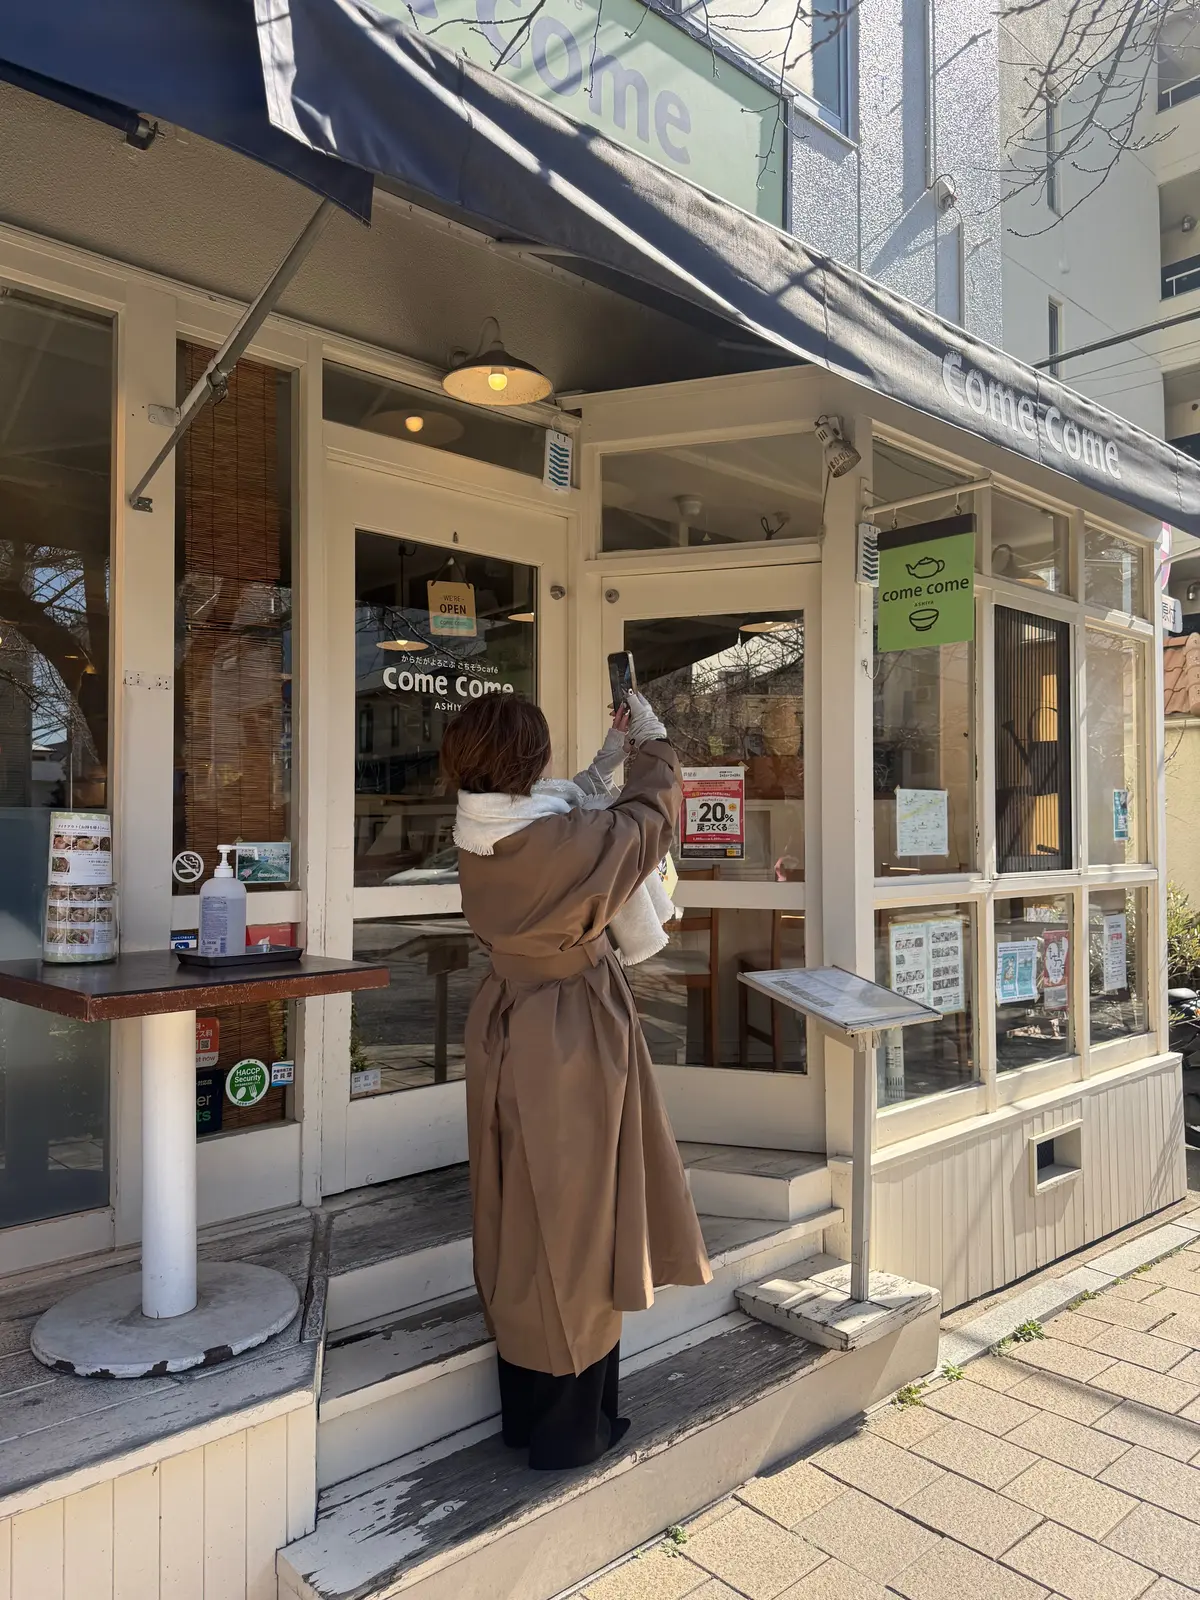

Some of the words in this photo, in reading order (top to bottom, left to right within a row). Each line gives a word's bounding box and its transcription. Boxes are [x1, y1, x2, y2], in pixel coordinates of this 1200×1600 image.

[942, 350, 1038, 440] Come
[1044, 405, 1122, 480] Come
[882, 586, 923, 603] come
[926, 577, 970, 596] come
[439, 603, 467, 615] OPEN
[913, 600, 935, 608] ASHIYA
[401, 655, 456, 669] からだがよろこぶ
[457, 662, 499, 675] ごちそうcafé
[382, 667, 448, 696] Come
[434, 702, 468, 712] ASHIY
[699, 802, 734, 823] 20%
[696, 823, 728, 832] 戻ってくる
[235, 1067, 261, 1077] HACCP
[234, 1074, 262, 1084] Security
